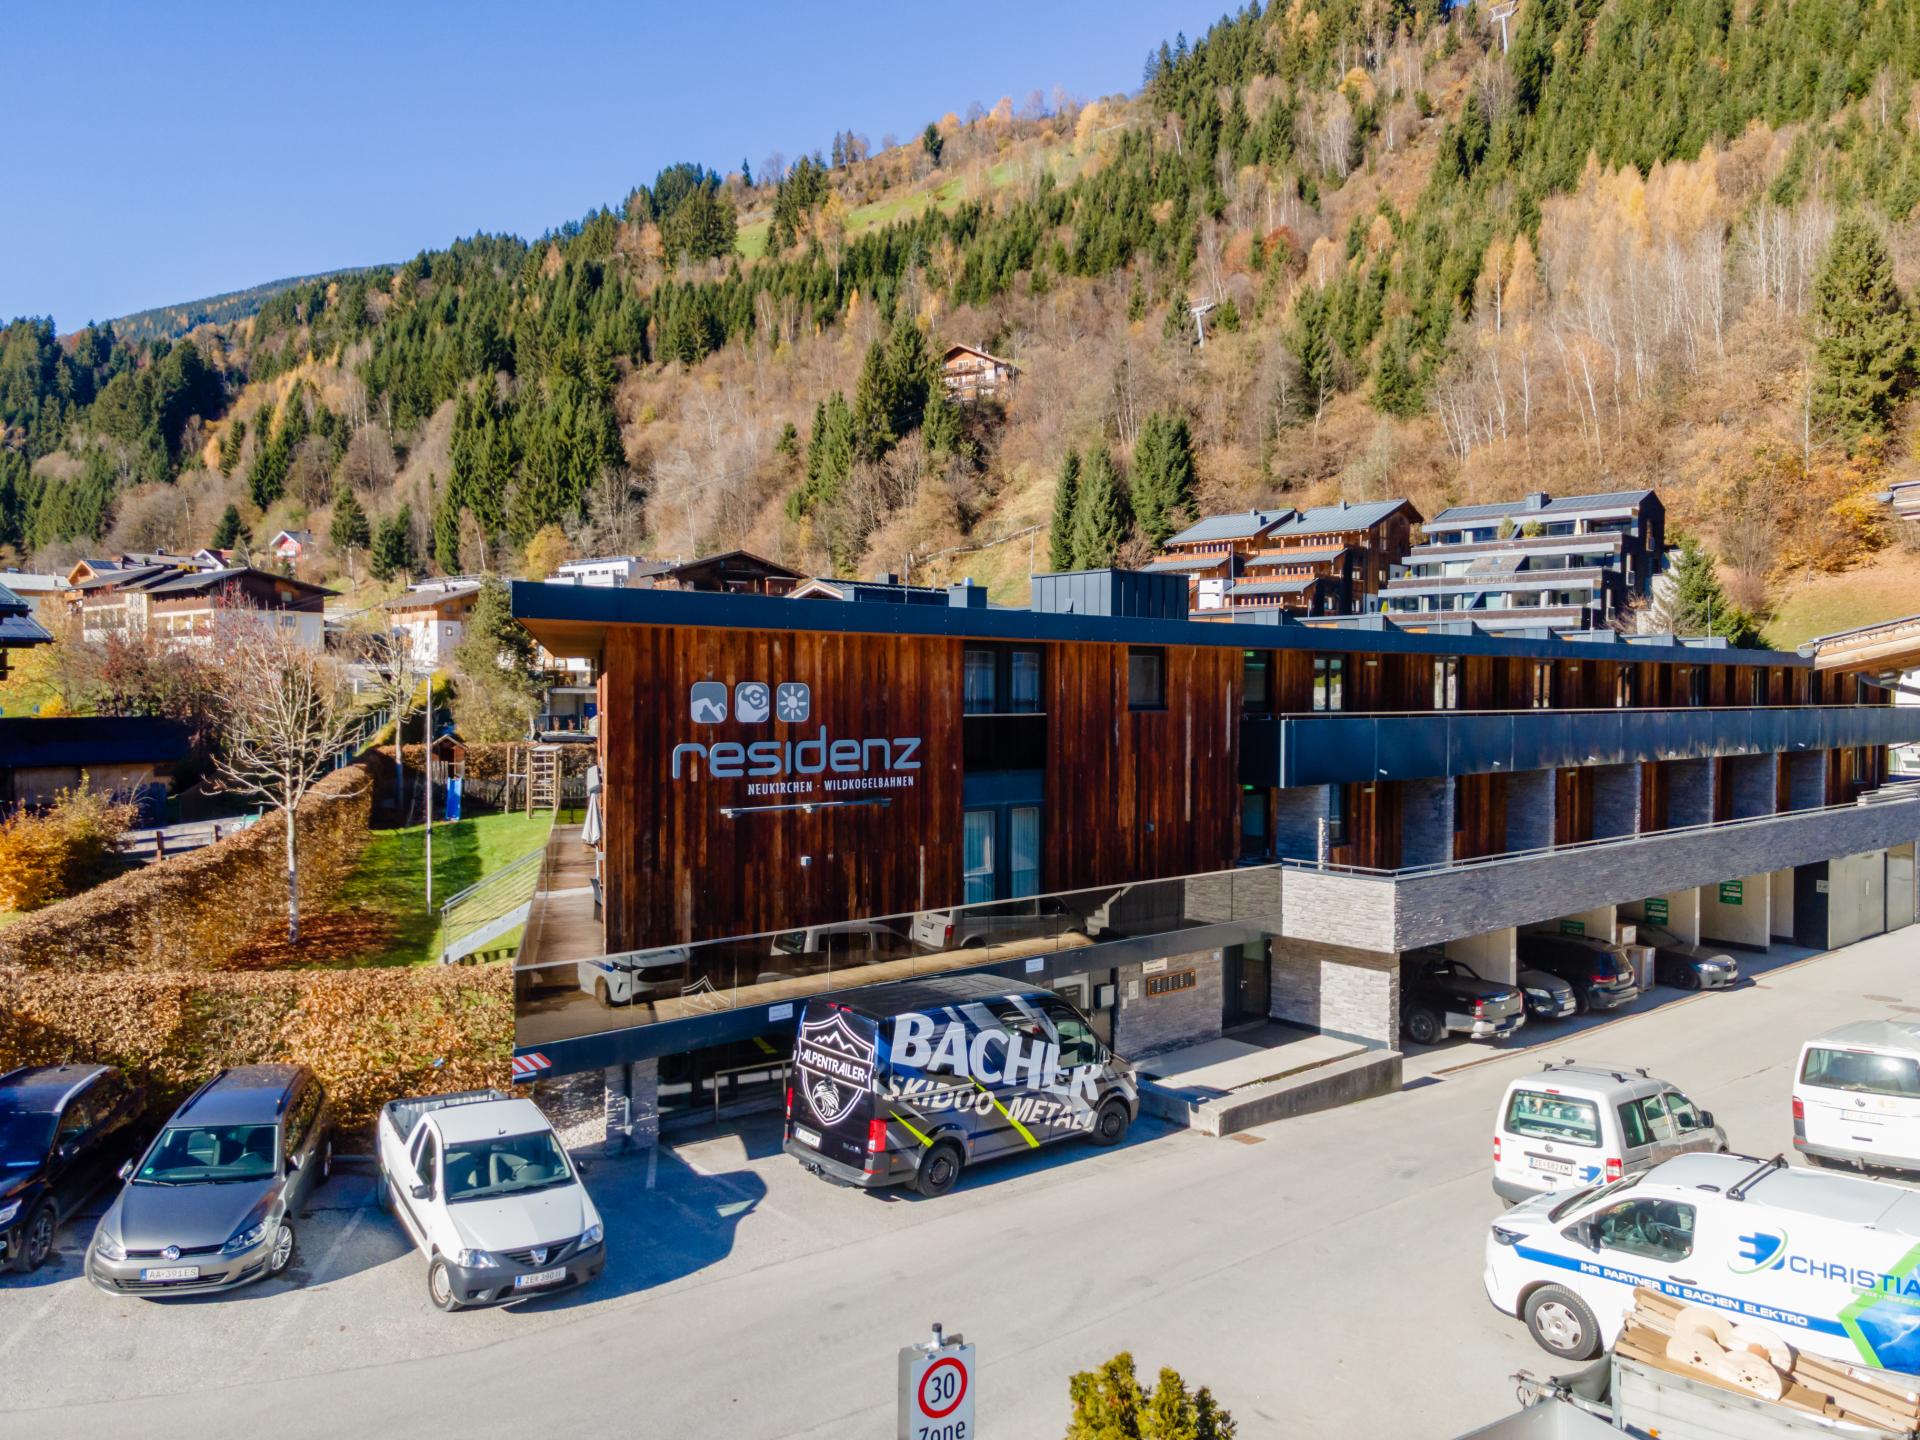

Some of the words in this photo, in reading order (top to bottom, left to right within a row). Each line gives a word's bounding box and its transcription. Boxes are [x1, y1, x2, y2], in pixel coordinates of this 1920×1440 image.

[672, 724, 922, 780] residenz
[747, 781, 813, 795] NEUKIRCHEN
[824, 776, 914, 791] WILDKOGELBAHNEN
[802, 1048, 865, 1082] ALPENTRAILER
[890, 1012, 1103, 1101] BACHER
[881, 1076, 995, 1115] SKIDOO
[1580, 1262, 1601, 1275] IHR
[1603, 1268, 1661, 1290] PARTNER
[1665, 1283, 1680, 1295] IN
[1682, 1288, 1740, 1310] SACHEN
[1743, 1304, 1809, 1326] ELEKTRO
[931, 1372, 955, 1404] 30
[919, 1421, 966, 1440] Zone
